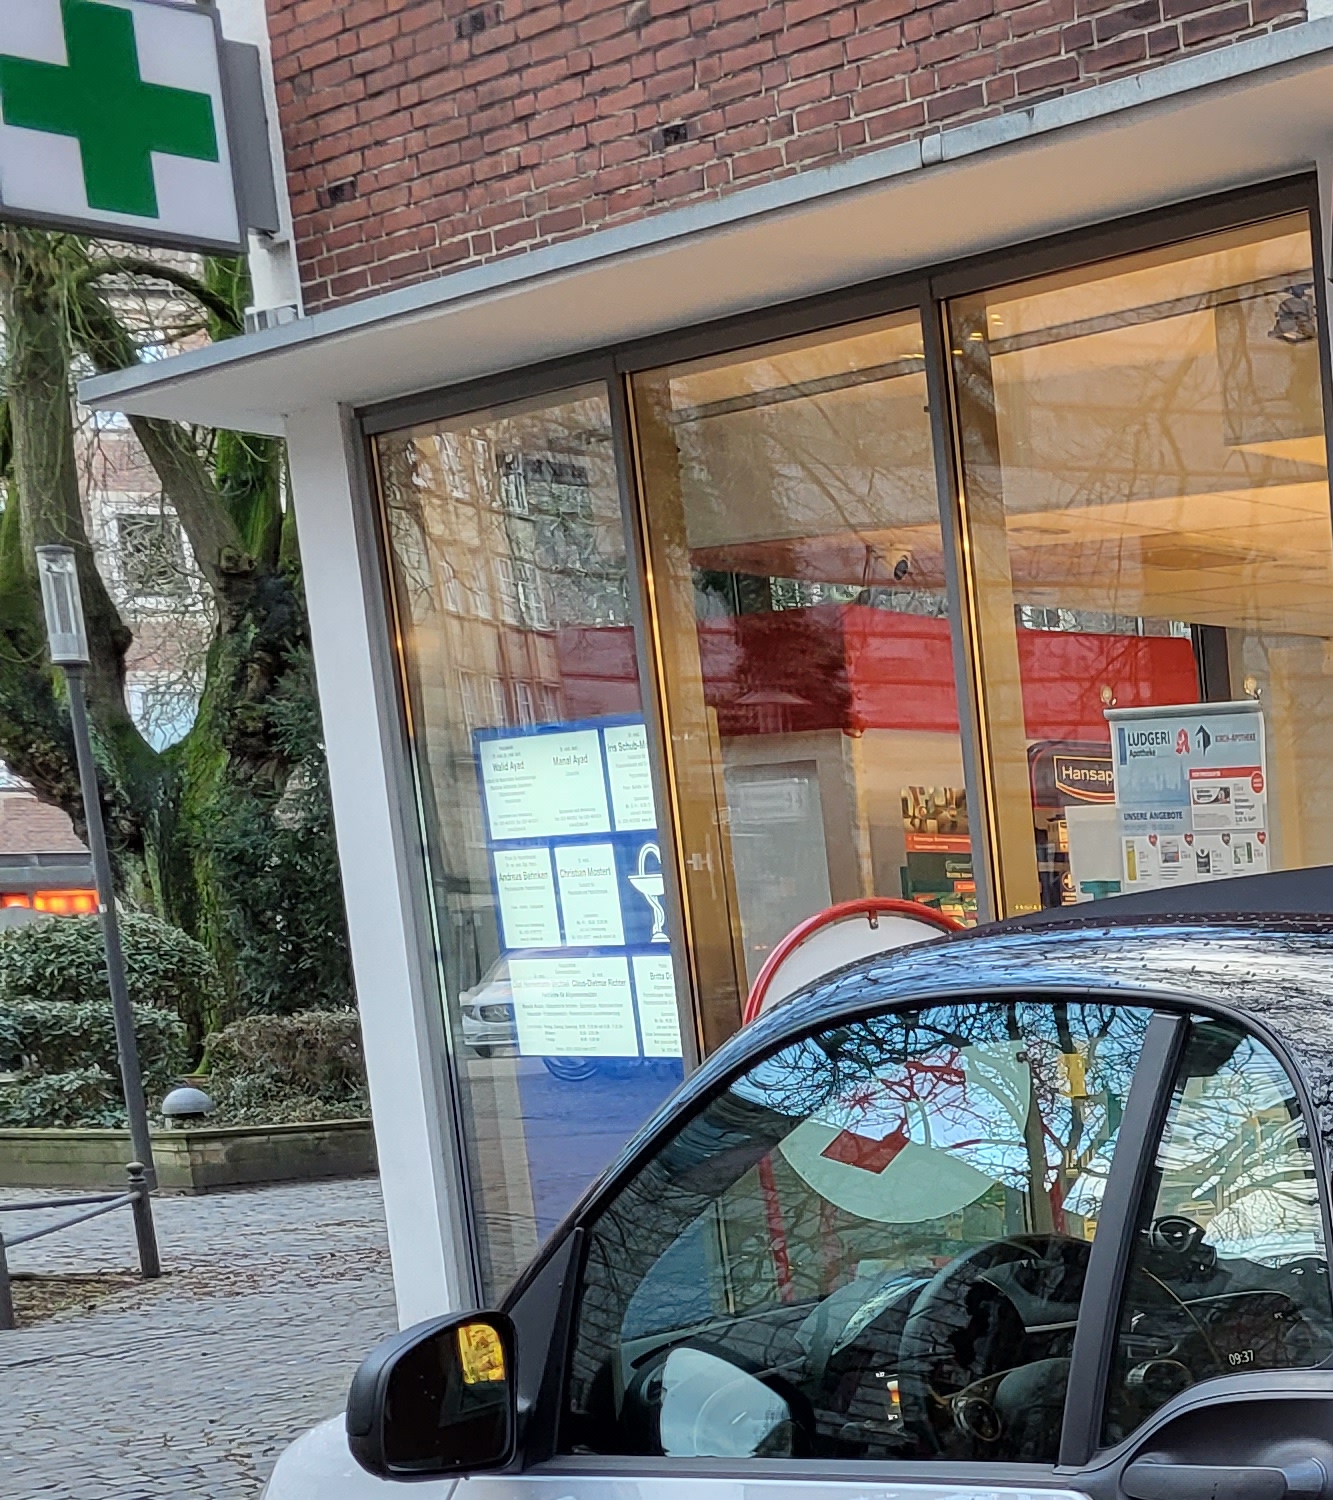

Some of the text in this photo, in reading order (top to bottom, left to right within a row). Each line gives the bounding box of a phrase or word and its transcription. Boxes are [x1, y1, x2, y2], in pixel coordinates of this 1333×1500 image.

[1127, 730, 1171, 748] LUDGERI
[1123, 811, 1183, 821] UNSERE ANGEBOTE
[1228, 1349, 1254, 1366] 09:37
